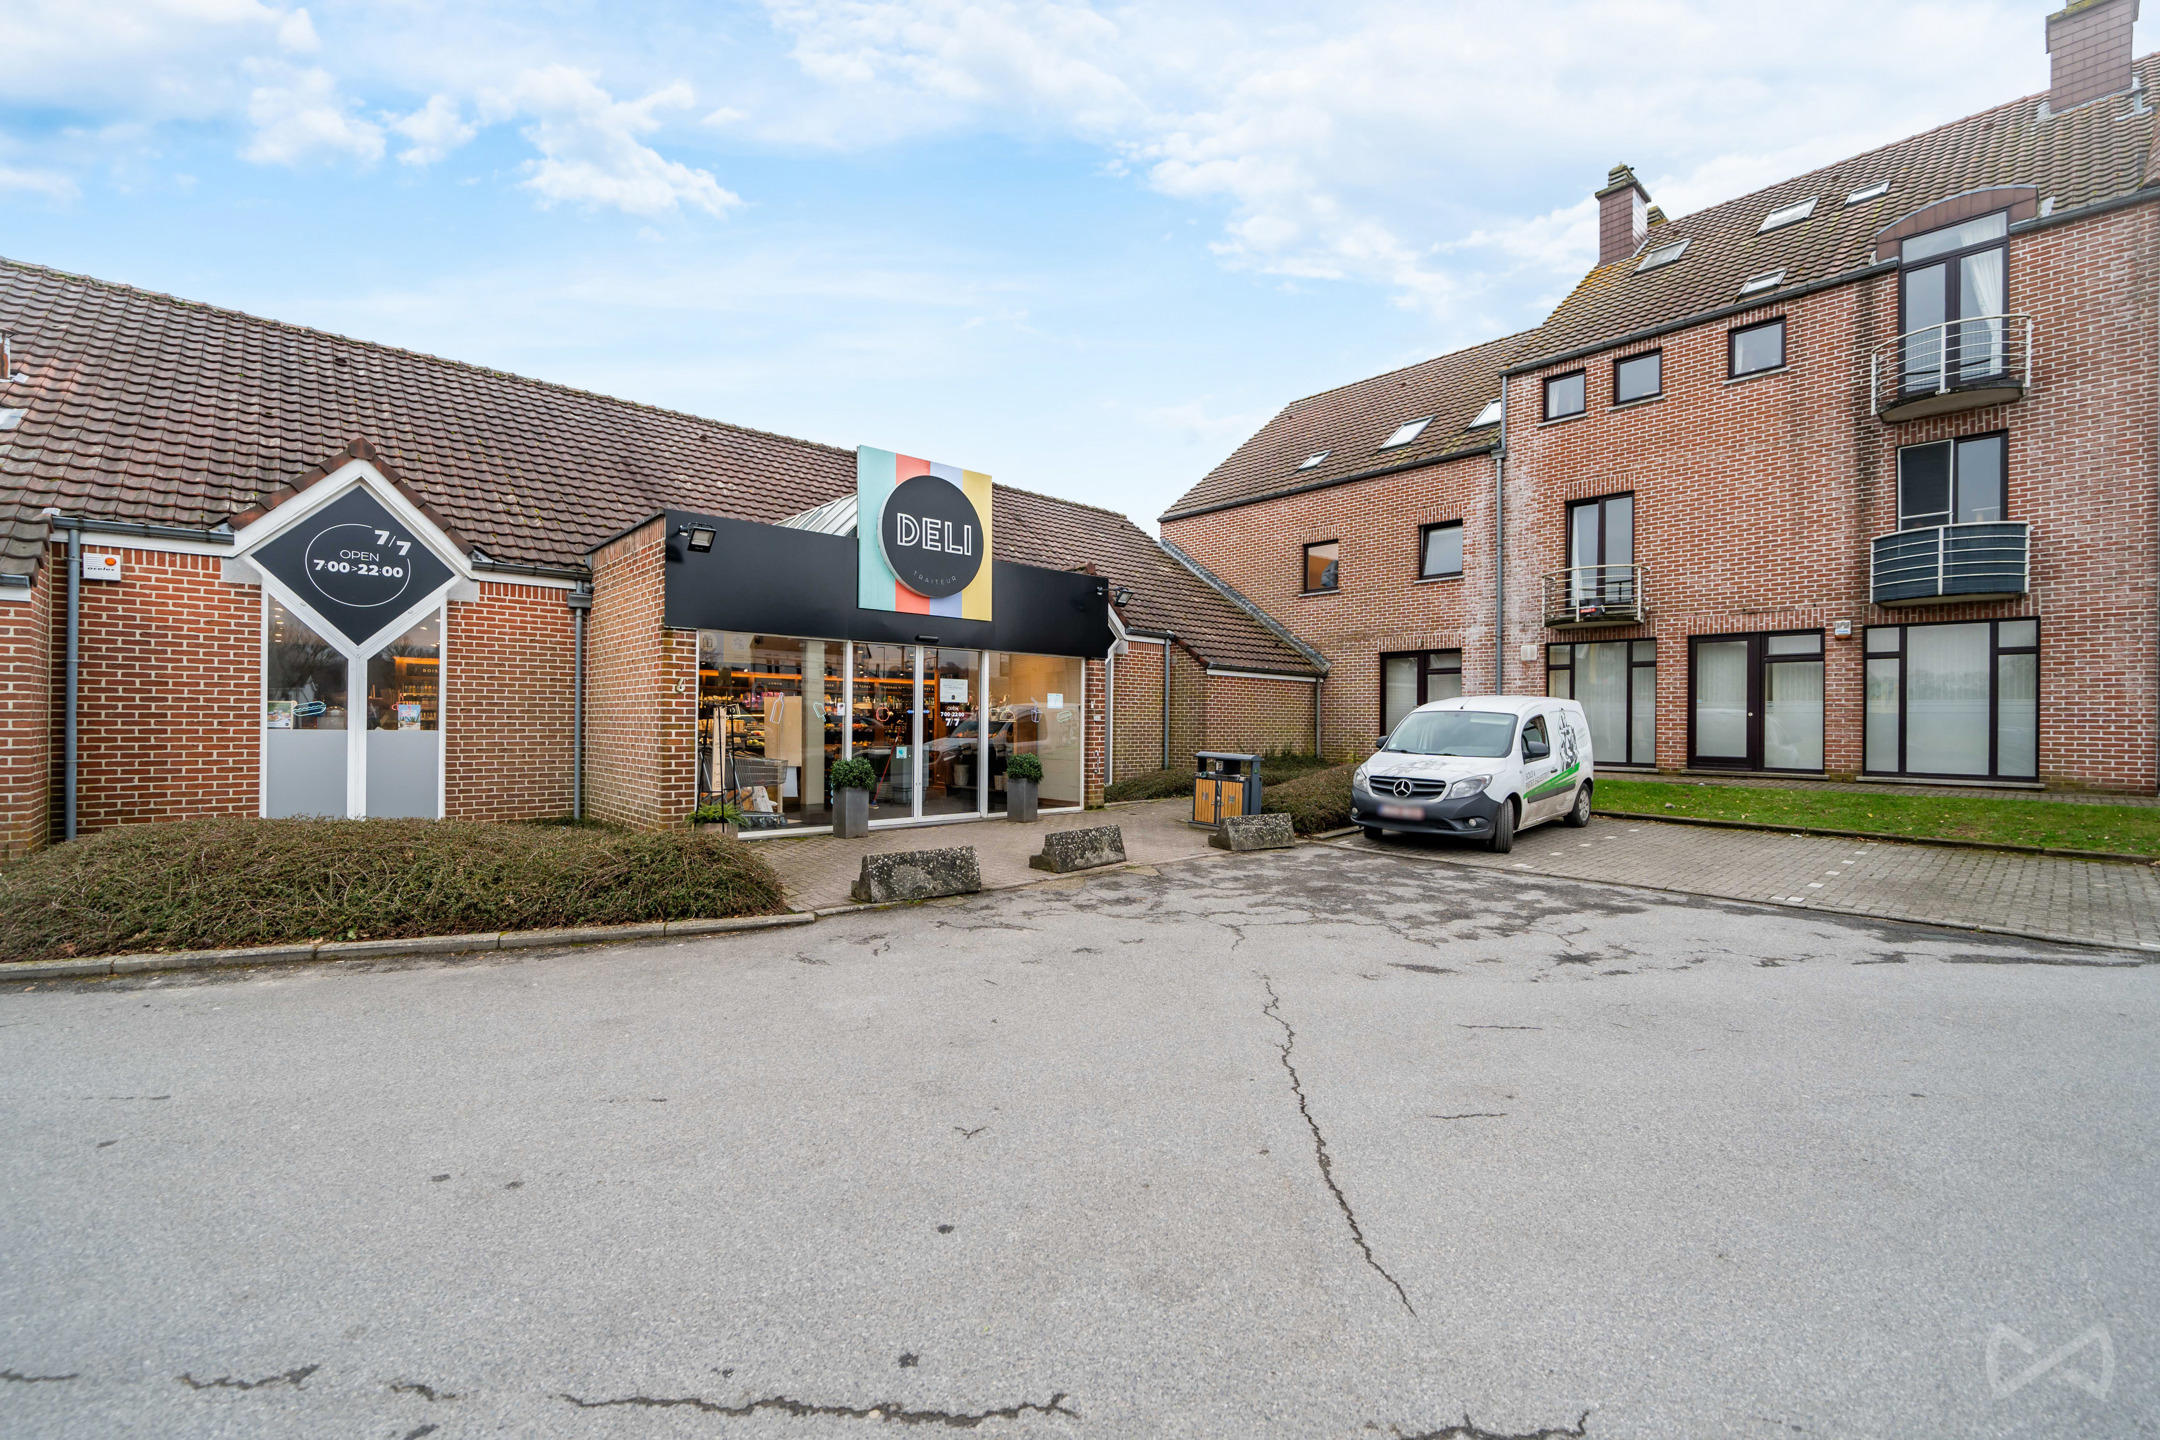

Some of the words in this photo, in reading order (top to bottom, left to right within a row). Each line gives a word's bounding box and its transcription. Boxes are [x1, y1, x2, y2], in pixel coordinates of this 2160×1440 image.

[897, 512, 972, 556] DELI
[374, 530, 412, 556] 7/7
[340, 549, 380, 562] OPEN
[913, 570, 957, 586] TRAITEUR
[945, 717, 960, 726] 7/7
